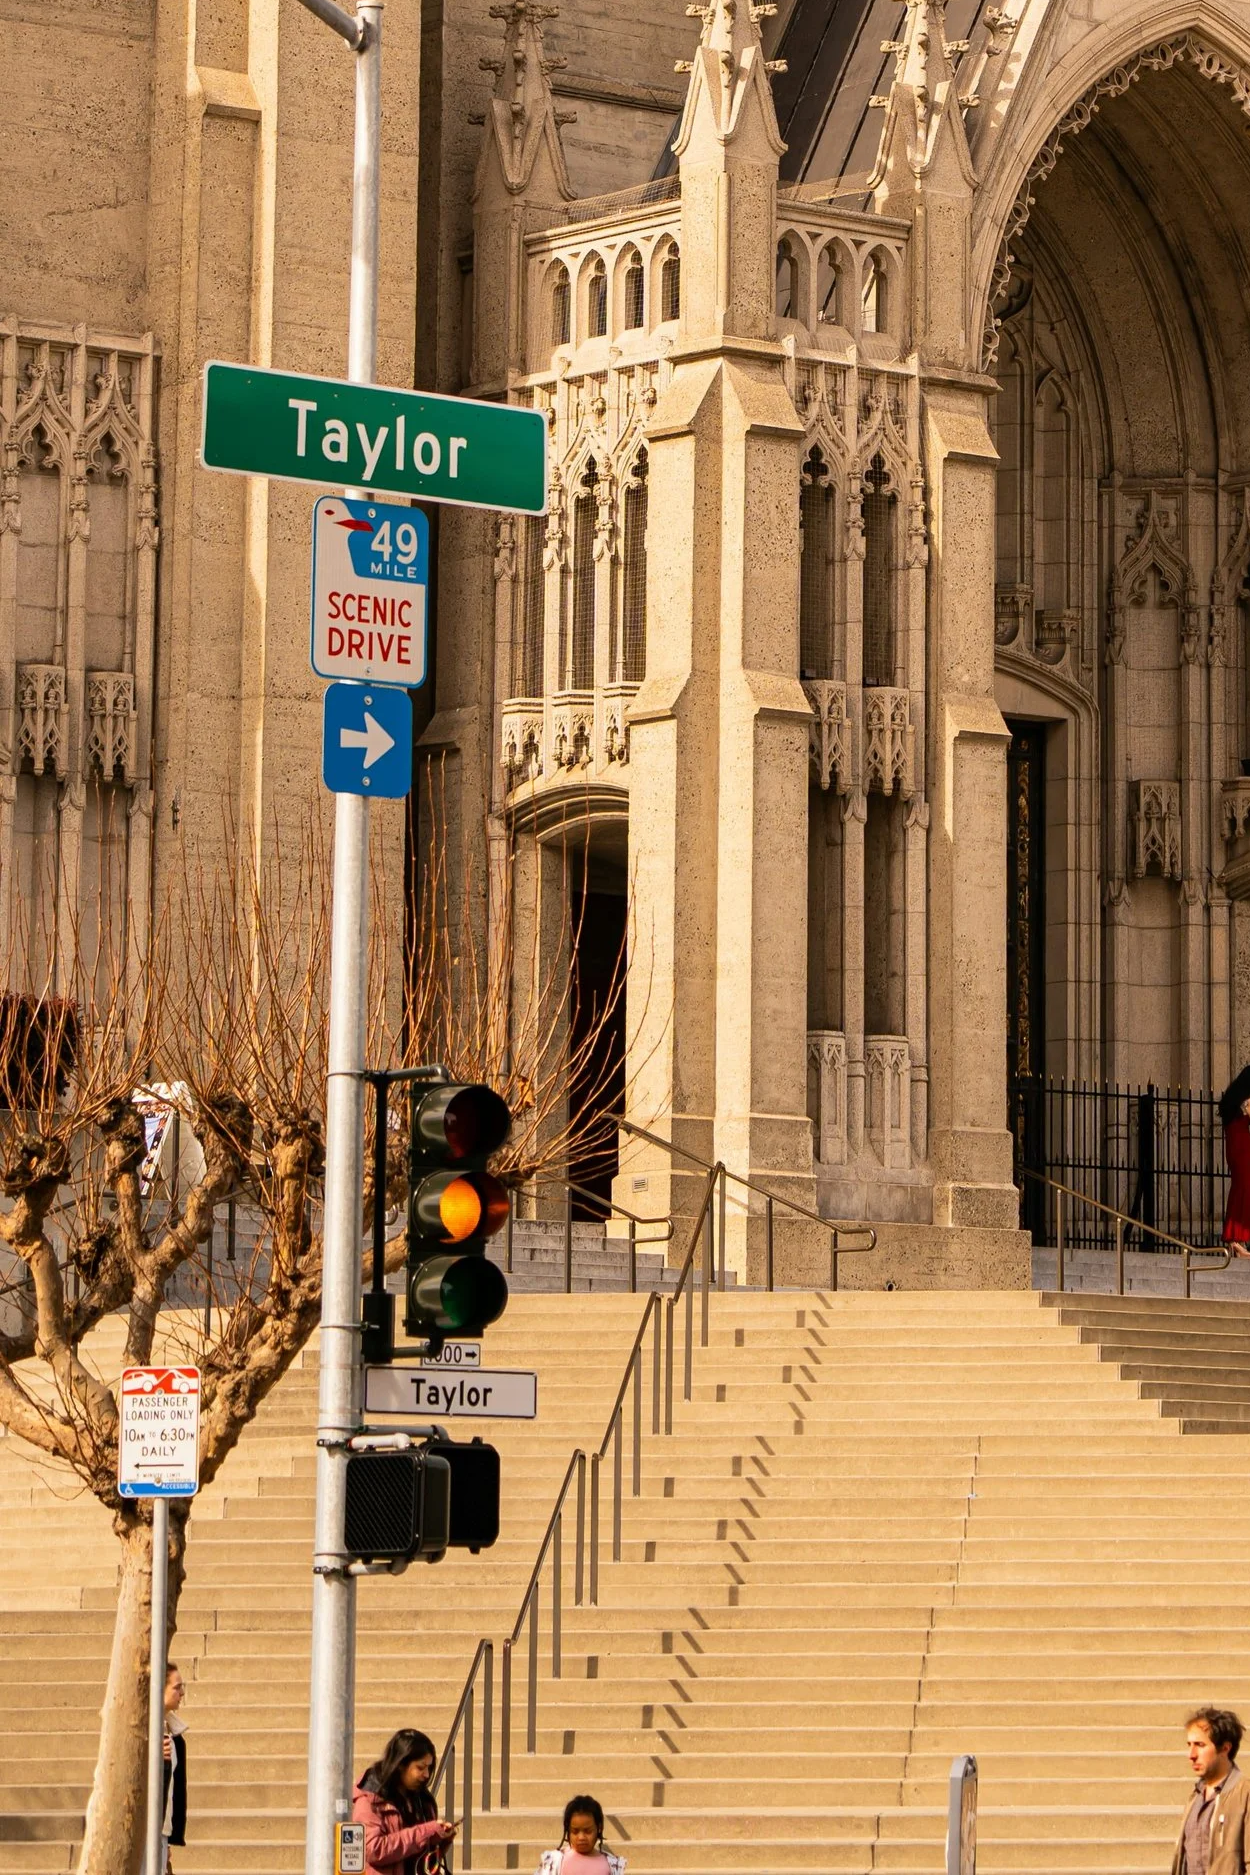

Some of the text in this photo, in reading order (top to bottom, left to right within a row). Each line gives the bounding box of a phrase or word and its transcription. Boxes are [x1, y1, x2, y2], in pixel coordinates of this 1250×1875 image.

[288, 398, 467, 481] Taylor
[370, 521, 418, 564] 49
[370, 562, 417, 579] MILE
[327, 591, 412, 628] SCENIC
[327, 627, 412, 665] DRIVE
[132, 1397, 188, 1407] PASSENGER
[411, 1378, 492, 1412] Taylor
[125, 1409, 194, 1421] LOADING ONLY
[141, 1446, 176, 1457] DAILY
